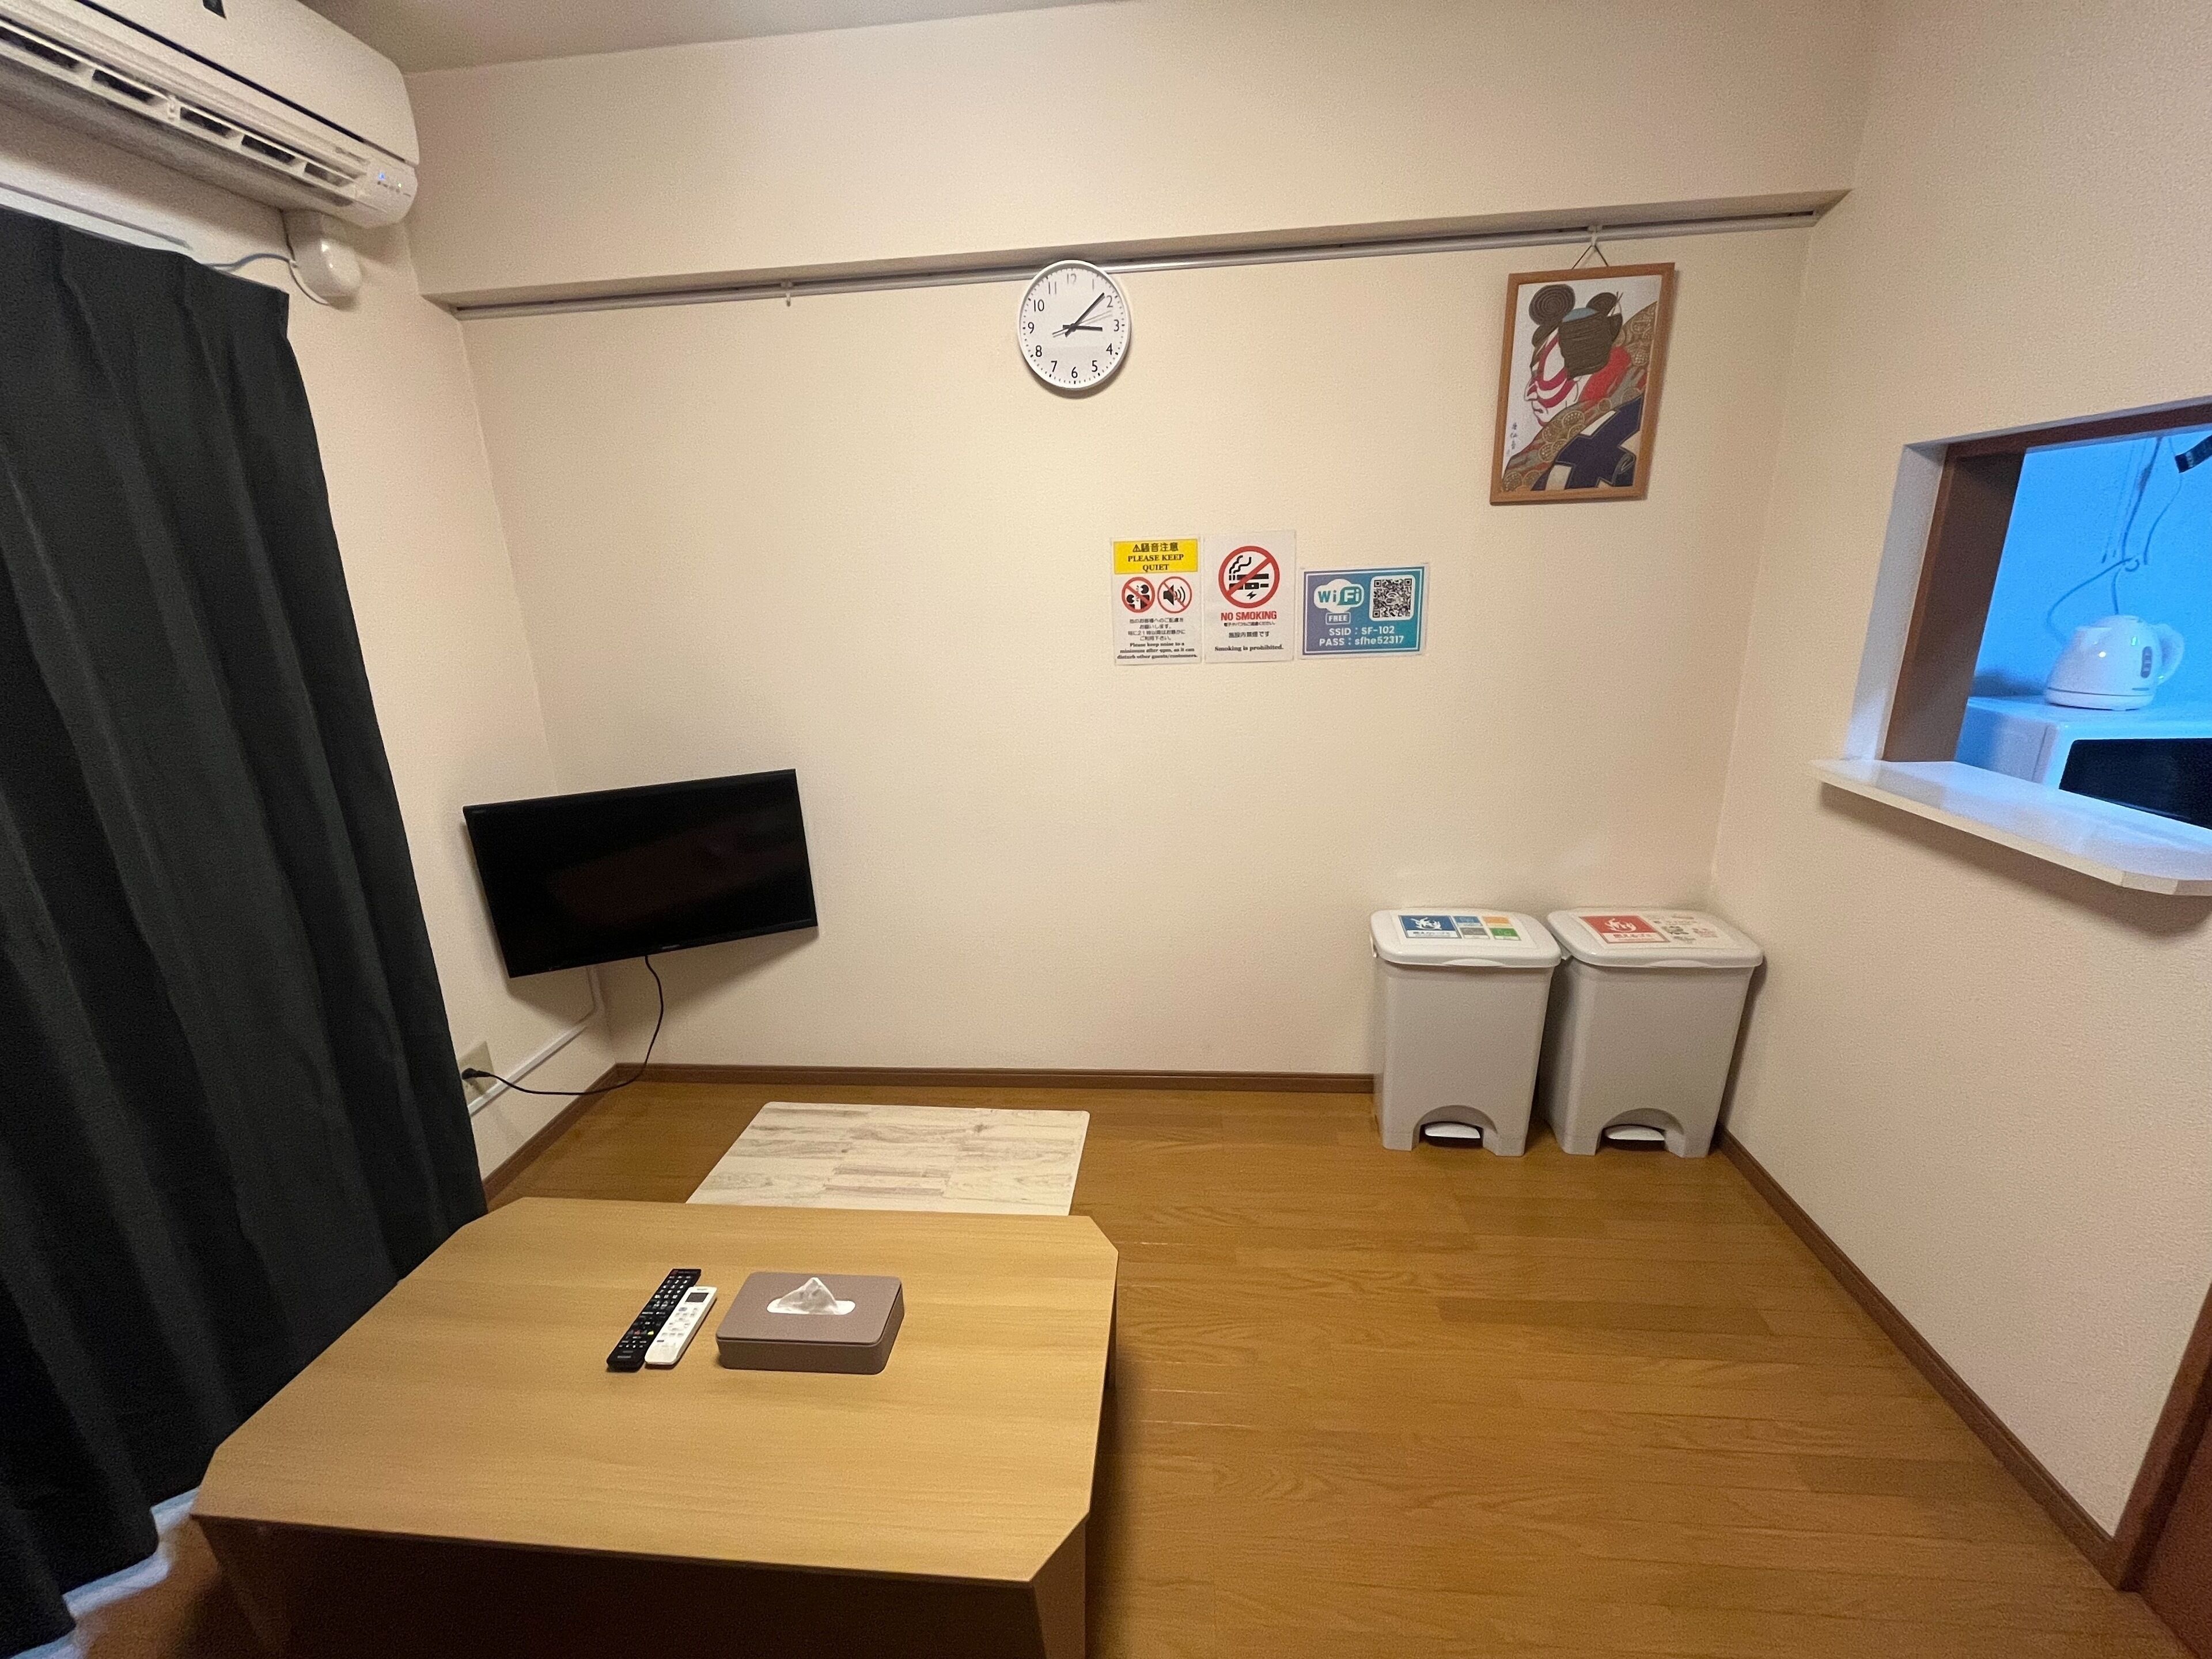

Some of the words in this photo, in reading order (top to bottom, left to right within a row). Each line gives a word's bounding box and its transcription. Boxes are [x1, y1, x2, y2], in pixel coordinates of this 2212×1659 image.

[1066, 273, 1077, 285] 12
[1048, 282, 1057, 295] 11
[1033, 299, 1044, 312] 10
[1106, 295, 1113, 308] 2
[1028, 321, 1035, 334] 9
[1113, 319, 1120, 332] 3
[1035, 345, 1042, 357] 8
[1106, 343, 1113, 355] 4
[1051, 360, 1058, 373] 7
[1071, 366, 1078, 378] 6
[1092, 360, 1098, 372] 5
[1142, 564, 1169, 573] QUIET
[1221, 612, 1233, 621] NO
[1236, 611, 1277, 620] SMOKING
[1328, 614, 1348, 622] FREE
[1329, 627, 1351, 636] SSID
[1361, 626, 1395, 635] SF-102
[1319, 638, 1344, 646] PASS
